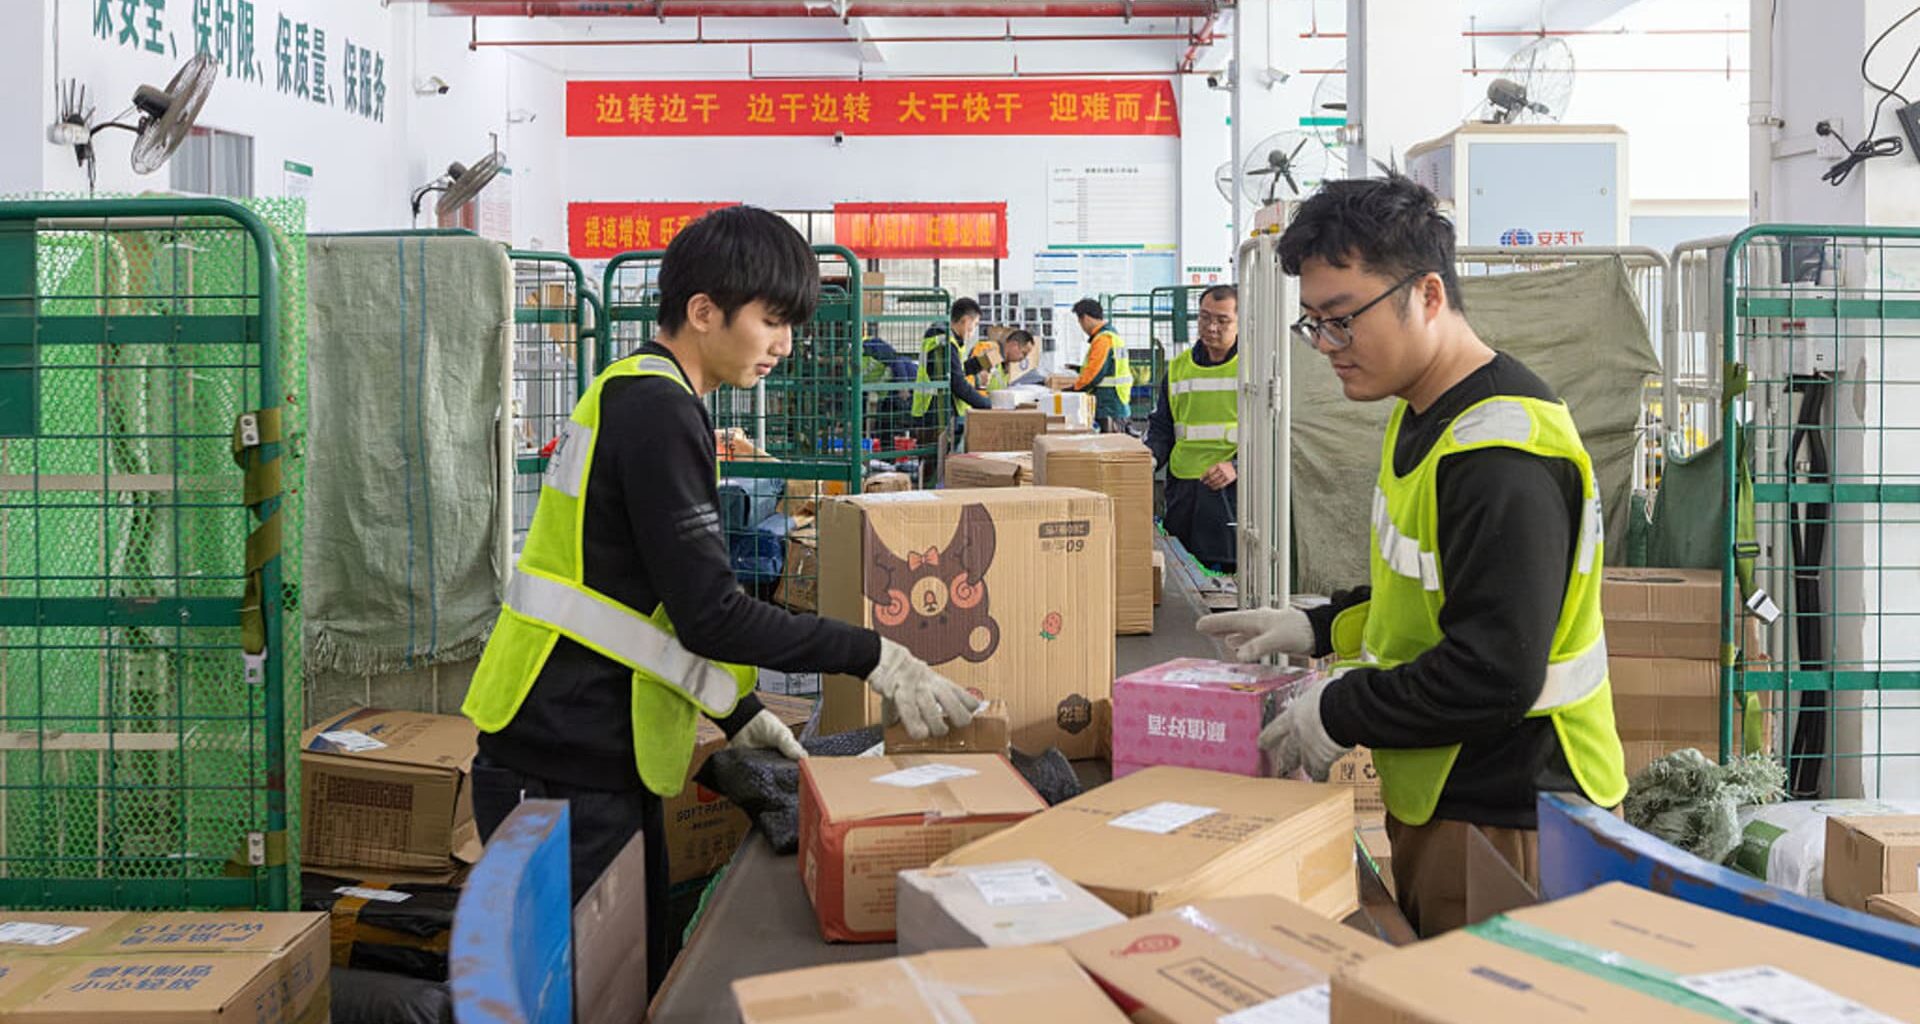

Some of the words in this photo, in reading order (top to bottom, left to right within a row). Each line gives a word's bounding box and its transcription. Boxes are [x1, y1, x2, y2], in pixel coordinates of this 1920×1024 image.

[596, 92, 720, 124] 边转边干
[747, 92, 871, 124] 边干边转
[898, 91, 1023, 123] 大干快干
[1049, 91, 1173, 123] 迎难而上
[585, 215, 651, 248] 提速增效
[1148, 713, 1226, 743] 颜值好酒
[70, 979, 199, 993] 小心轻放
[88, 965, 213, 978] 塑料制品
